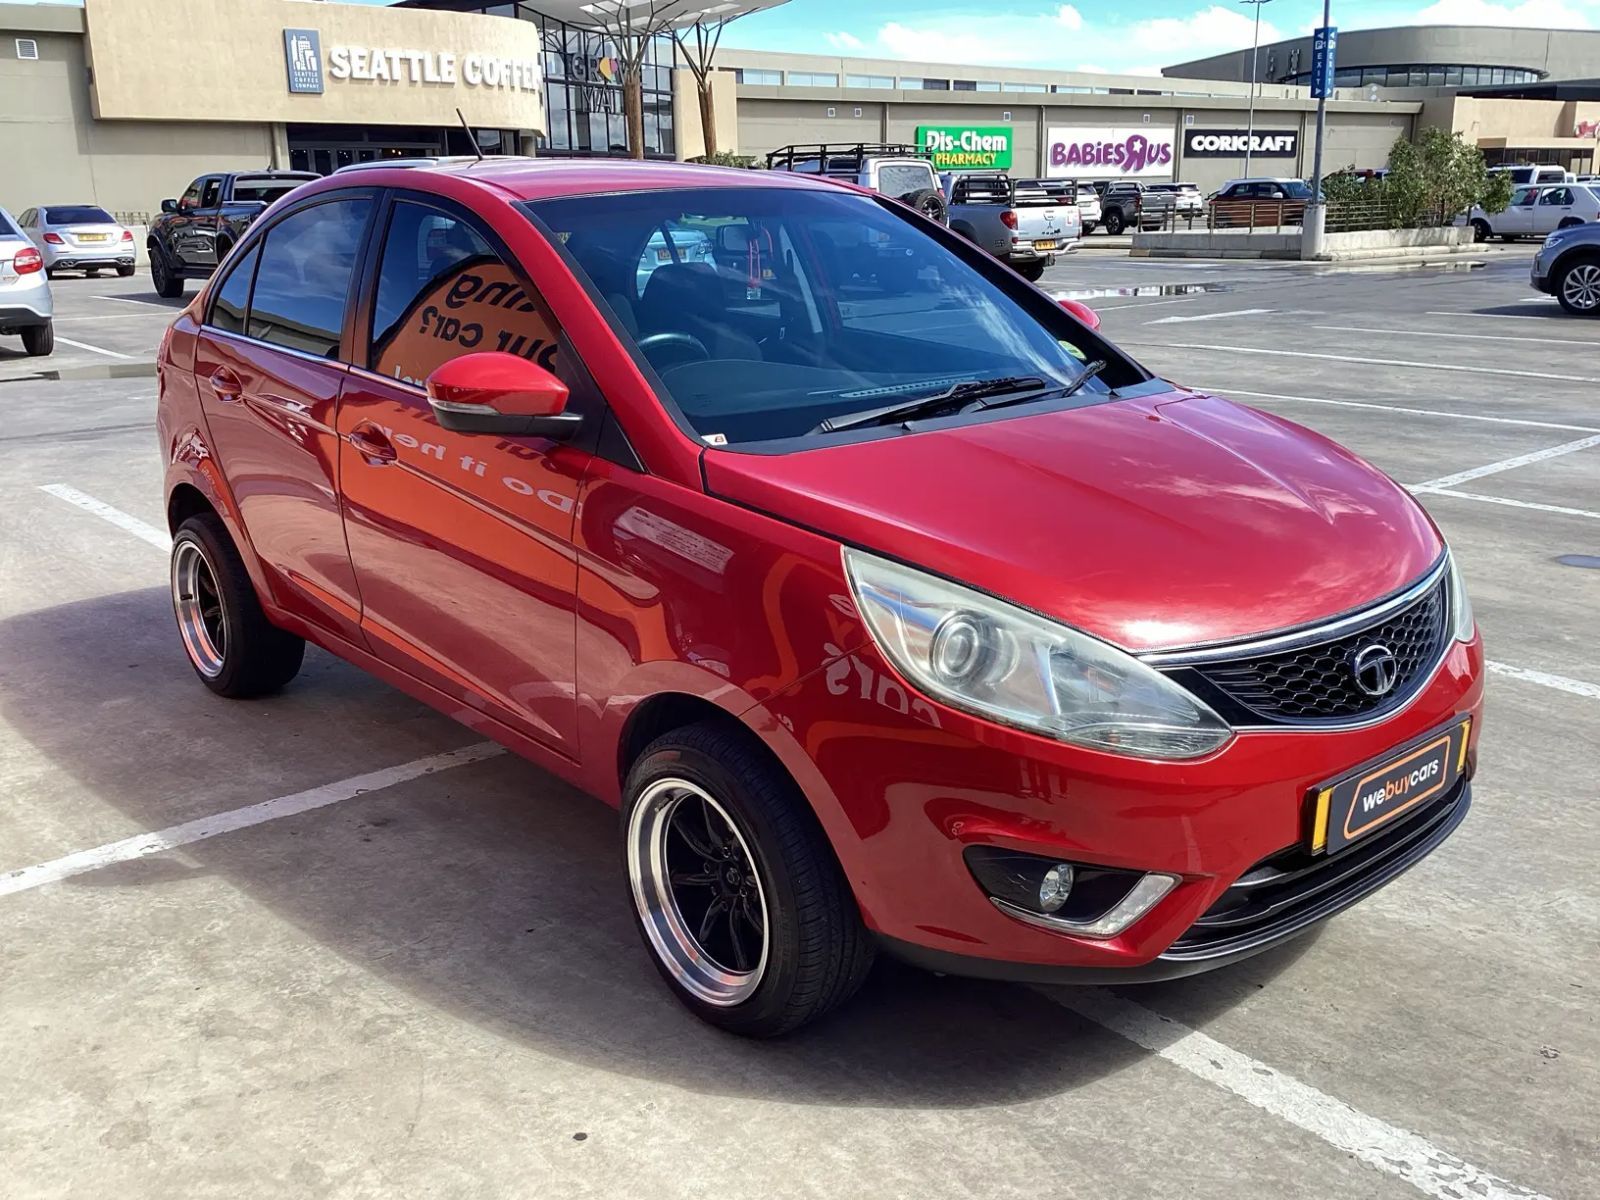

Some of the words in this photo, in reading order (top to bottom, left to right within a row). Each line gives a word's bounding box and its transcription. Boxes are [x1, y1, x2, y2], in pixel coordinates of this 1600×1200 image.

[329, 46, 456, 82] SEATTLE
[926, 130, 1008, 151] Dis-Chem
[1190, 135, 1295, 151] CORICRAFT
[935, 153, 997, 165] PHARMACY
[1362, 759, 1440, 812] webuycars
